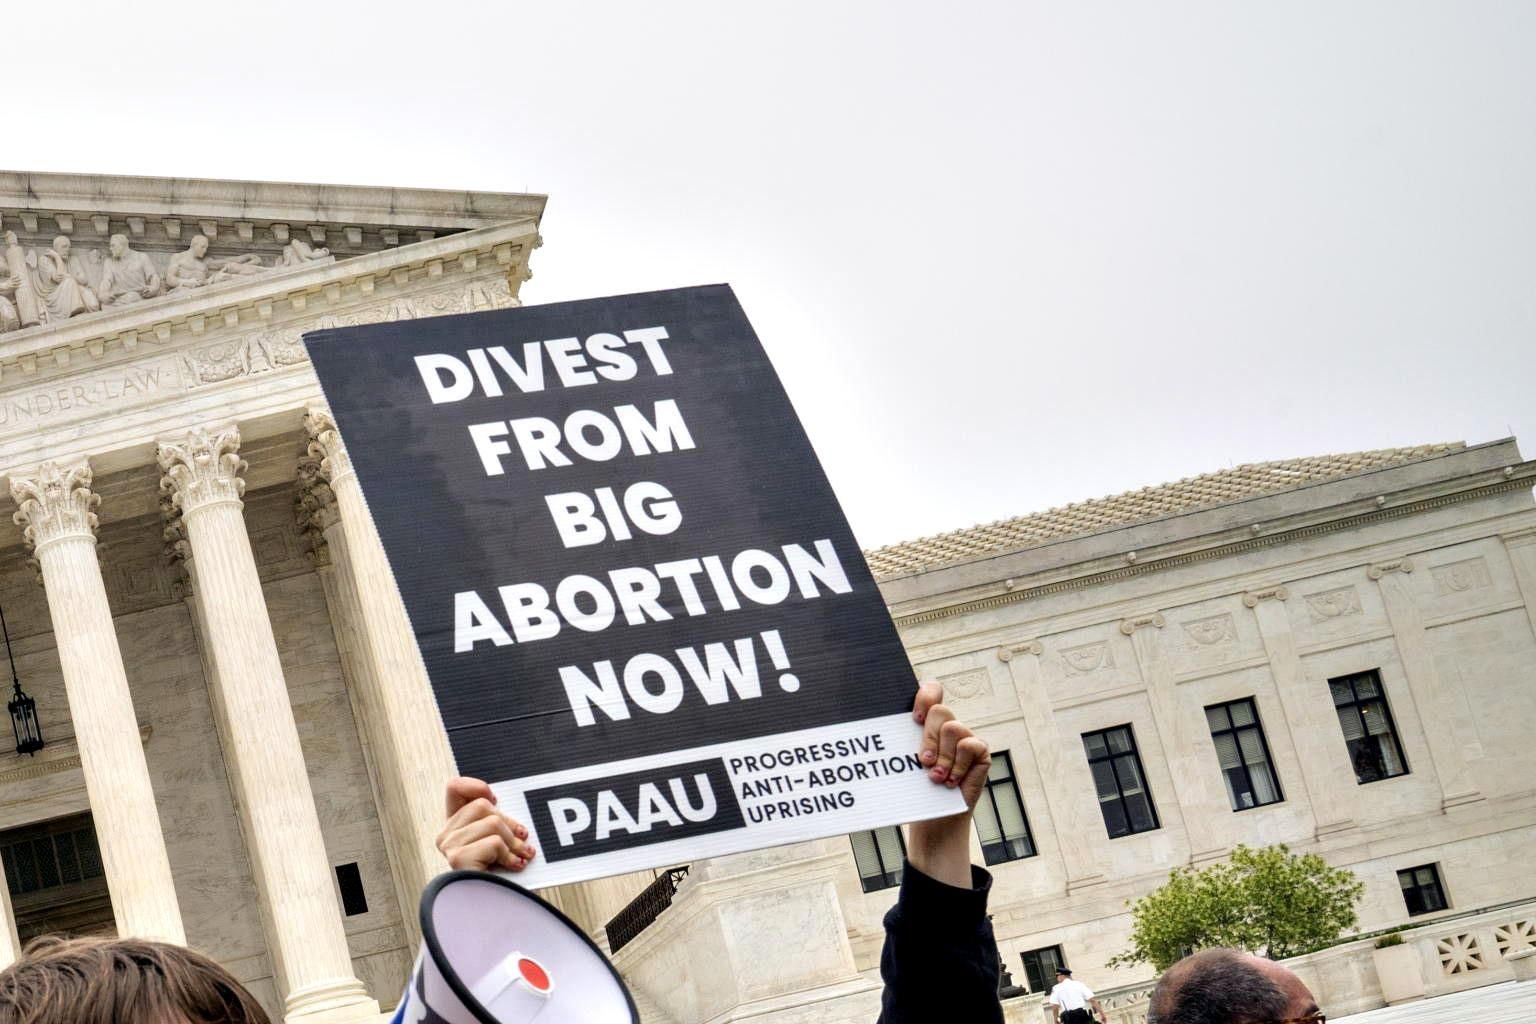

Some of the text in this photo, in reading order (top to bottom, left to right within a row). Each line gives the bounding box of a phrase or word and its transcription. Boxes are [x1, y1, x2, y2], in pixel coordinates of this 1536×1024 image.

[106, 367, 161, 401] LAW
[414, 326, 674, 404] DIVEST
[467, 399, 696, 476] FROM
[544, 481, 683, 548] BIG
[453, 539, 853, 653] ABORTION
[558, 629, 800, 727] NOW!
[730, 734, 885, 775] PROGRESSIVE
[741, 752, 924, 799] ANTI-ABORTION
[548, 773, 718, 847] PAAU
[747, 790, 856, 824] UPRISING
